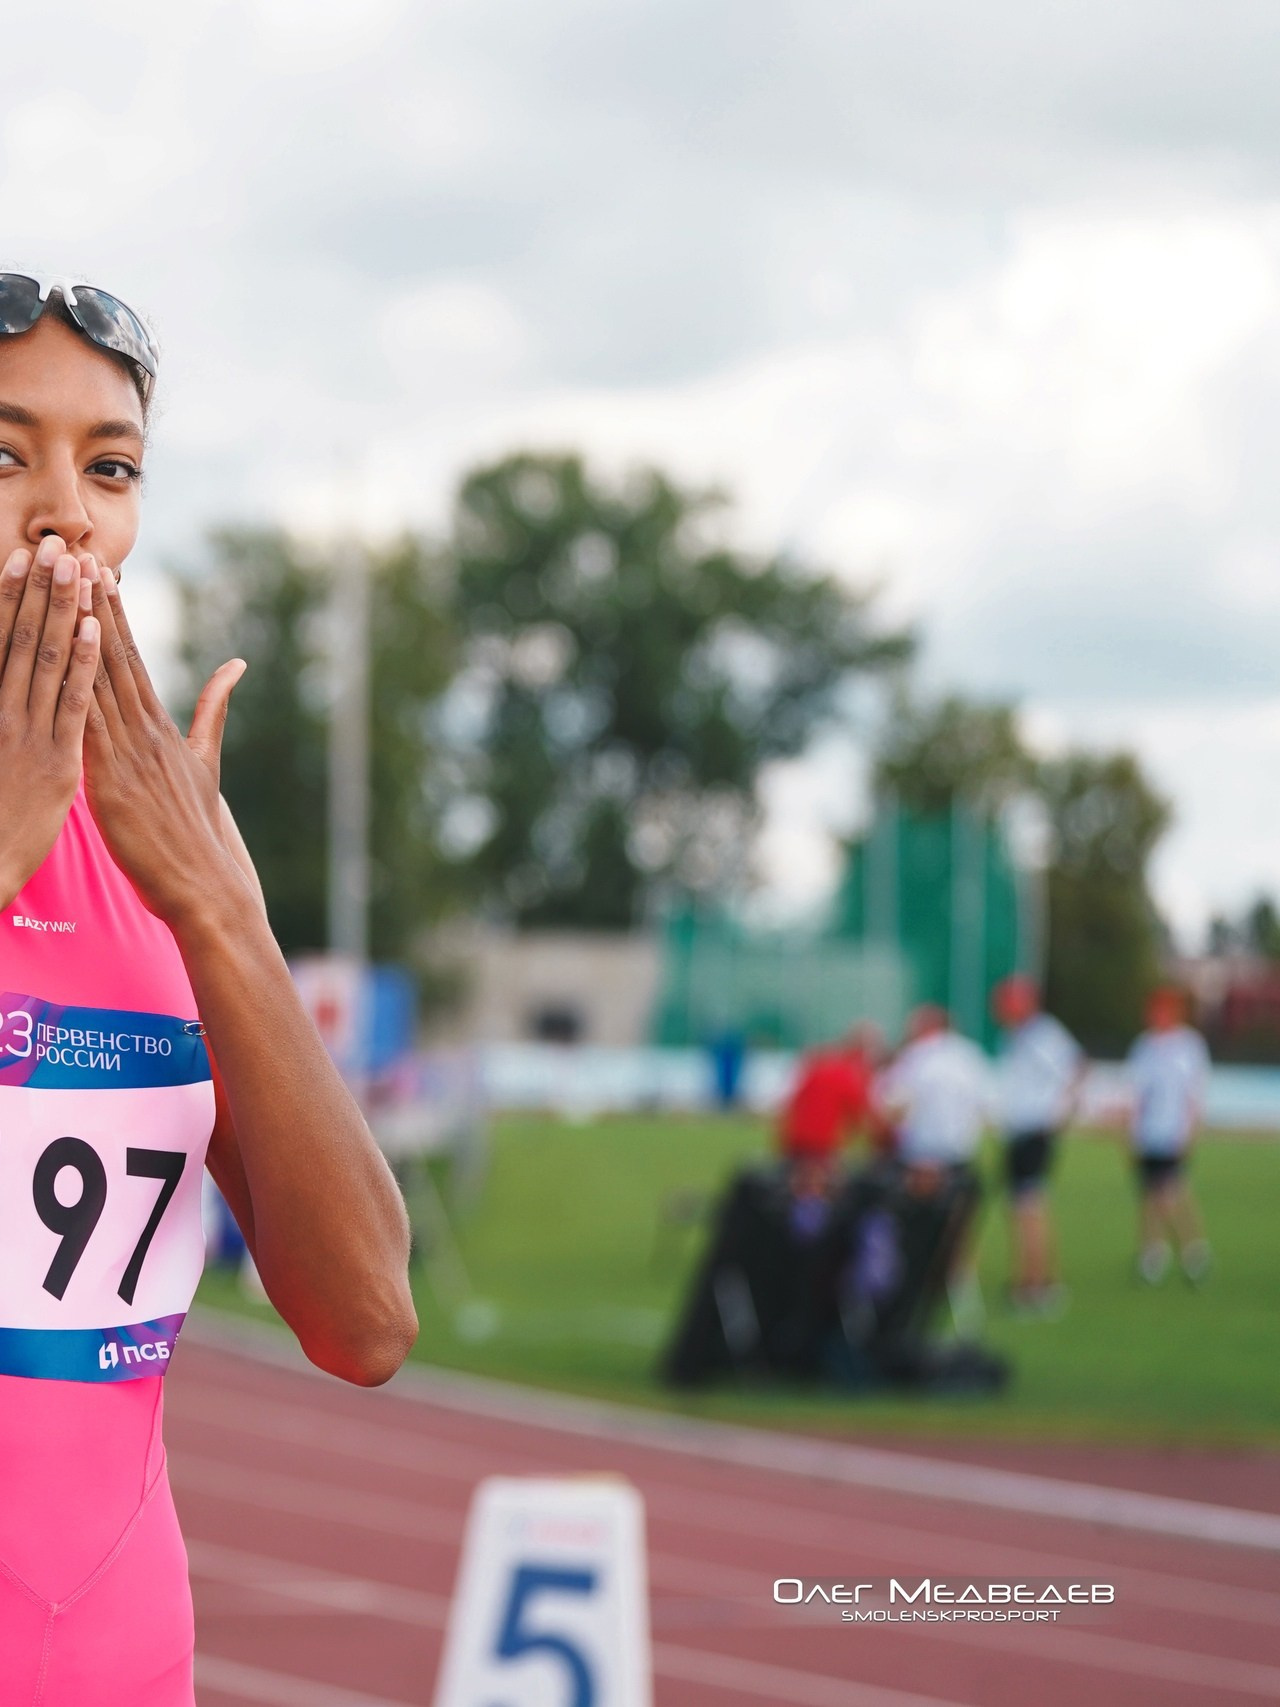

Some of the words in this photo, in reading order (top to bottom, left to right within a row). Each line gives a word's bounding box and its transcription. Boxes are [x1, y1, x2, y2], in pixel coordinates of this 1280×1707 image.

[36, 1022, 172, 1056] ПЕРВЕНСТВО
[36, 1043, 121, 1071] РОССИИ
[122, 1341, 171, 1365] ПСБ
[494, 1563, 599, 1707] 5
